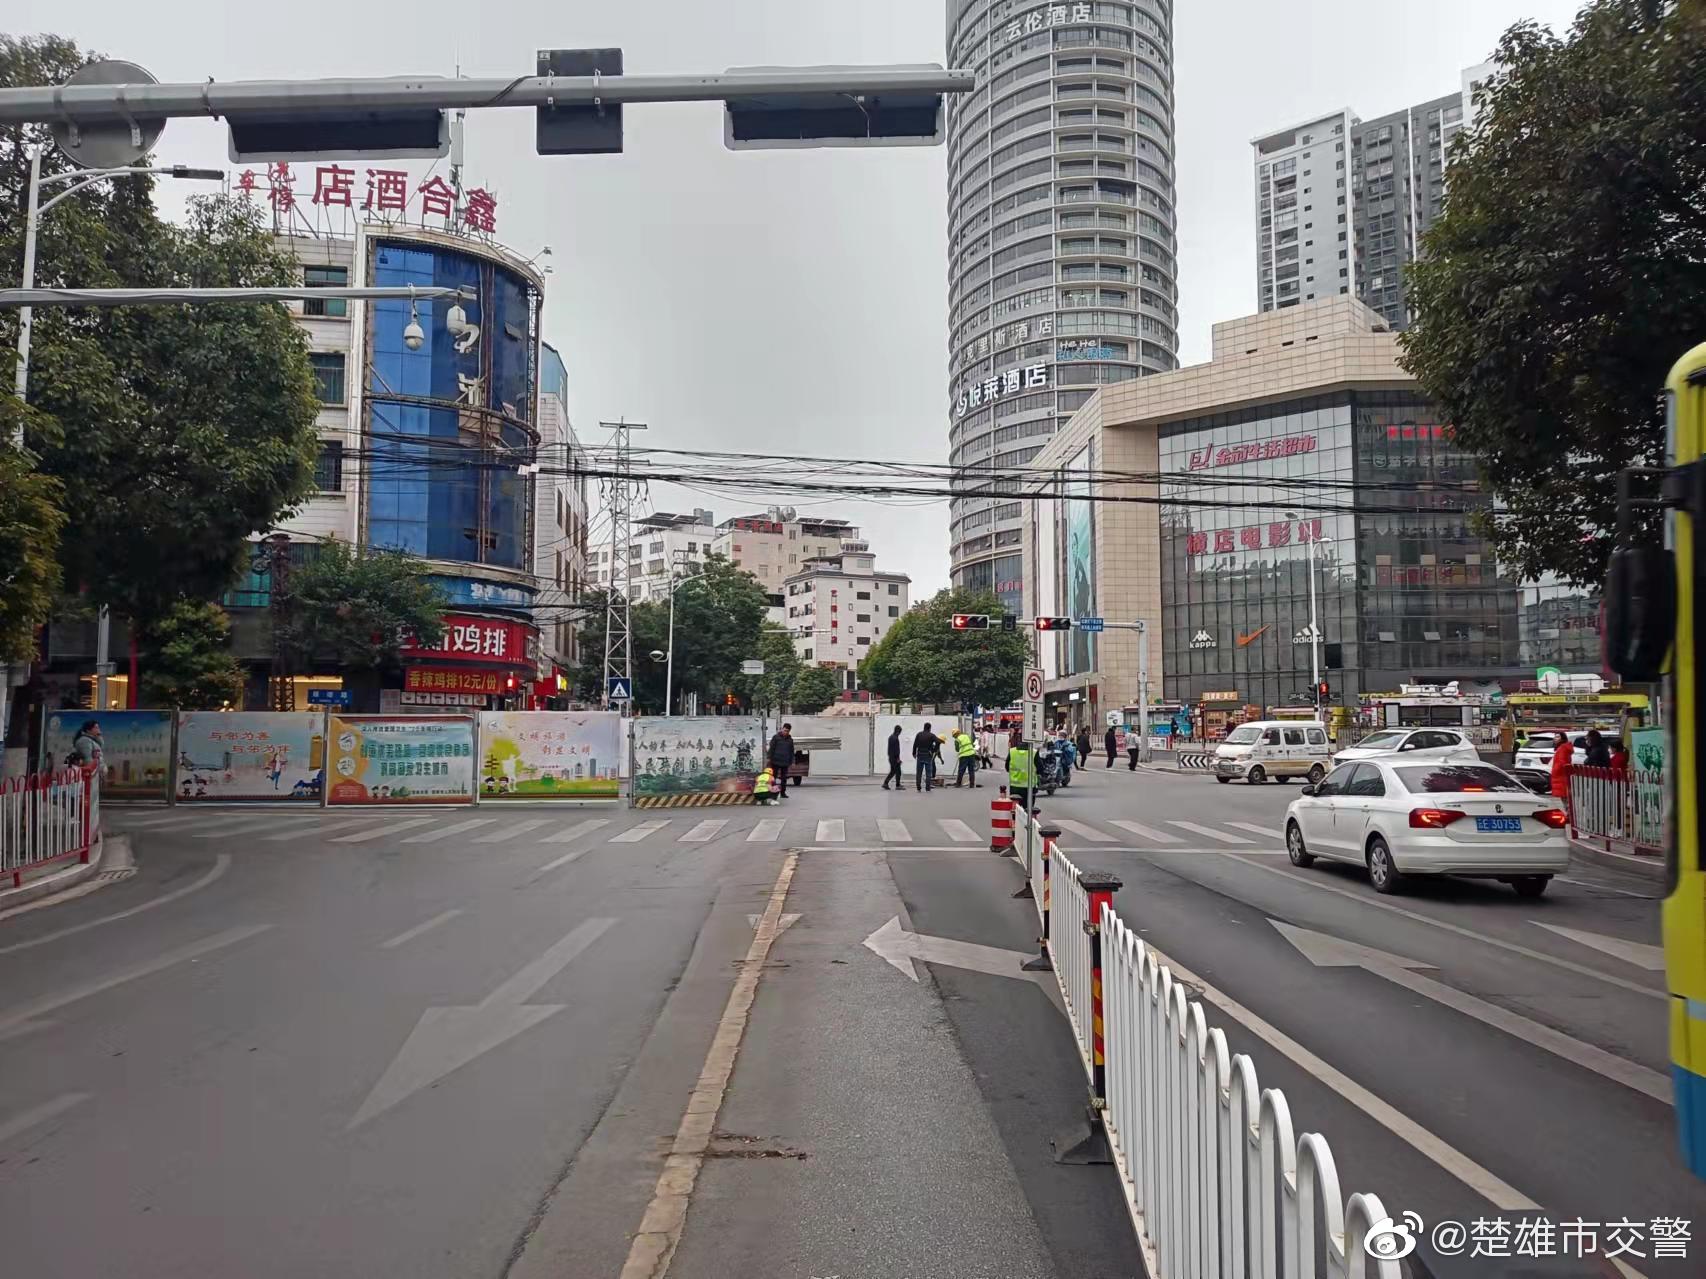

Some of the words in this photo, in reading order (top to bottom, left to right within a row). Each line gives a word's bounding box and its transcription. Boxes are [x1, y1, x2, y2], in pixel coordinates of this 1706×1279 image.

[1006, 2, 1090, 40] 云伦酒店
[409, 671, 497, 691] 香辣鸡排12元/份
